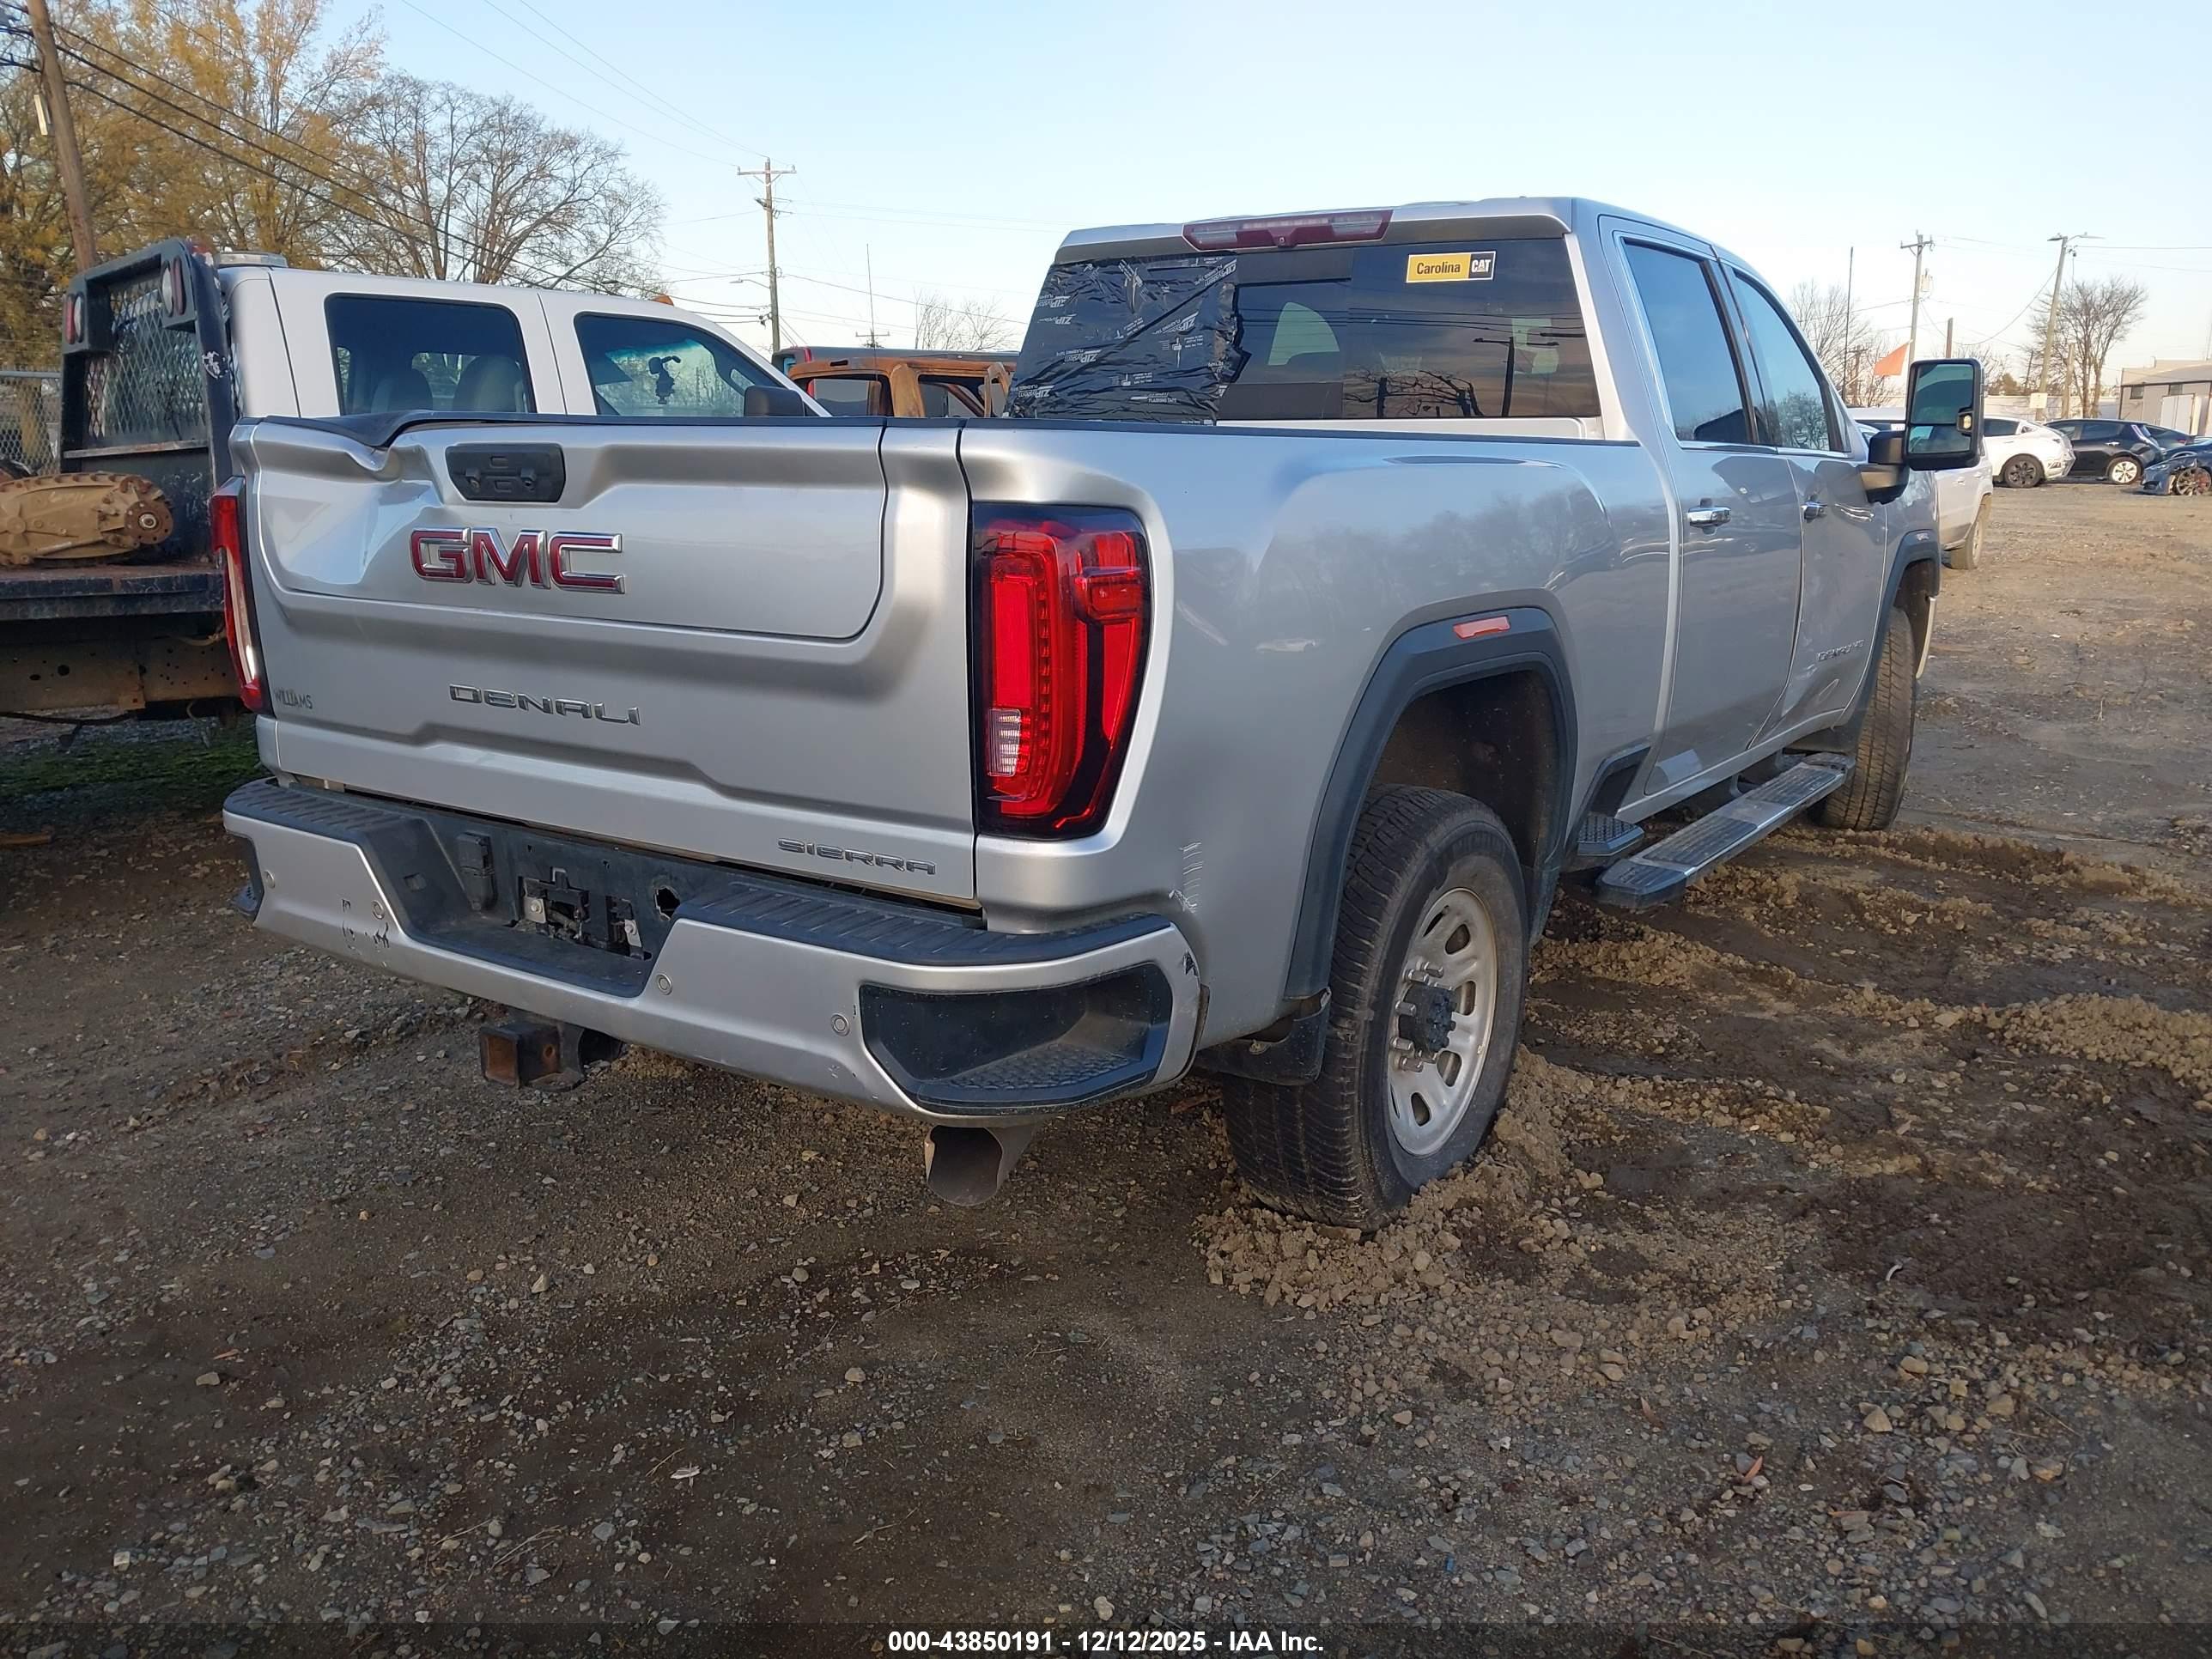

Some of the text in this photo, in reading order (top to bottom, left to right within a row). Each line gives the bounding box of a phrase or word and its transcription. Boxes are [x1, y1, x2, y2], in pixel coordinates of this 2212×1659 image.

[1417, 259, 1492, 275] Carolina CAT
[410, 527, 625, 594] GMC
[274, 690, 313, 709] WILLIAMS
[449, 684, 641, 726] DENALI
[777, 837, 936, 875] SIERRA
